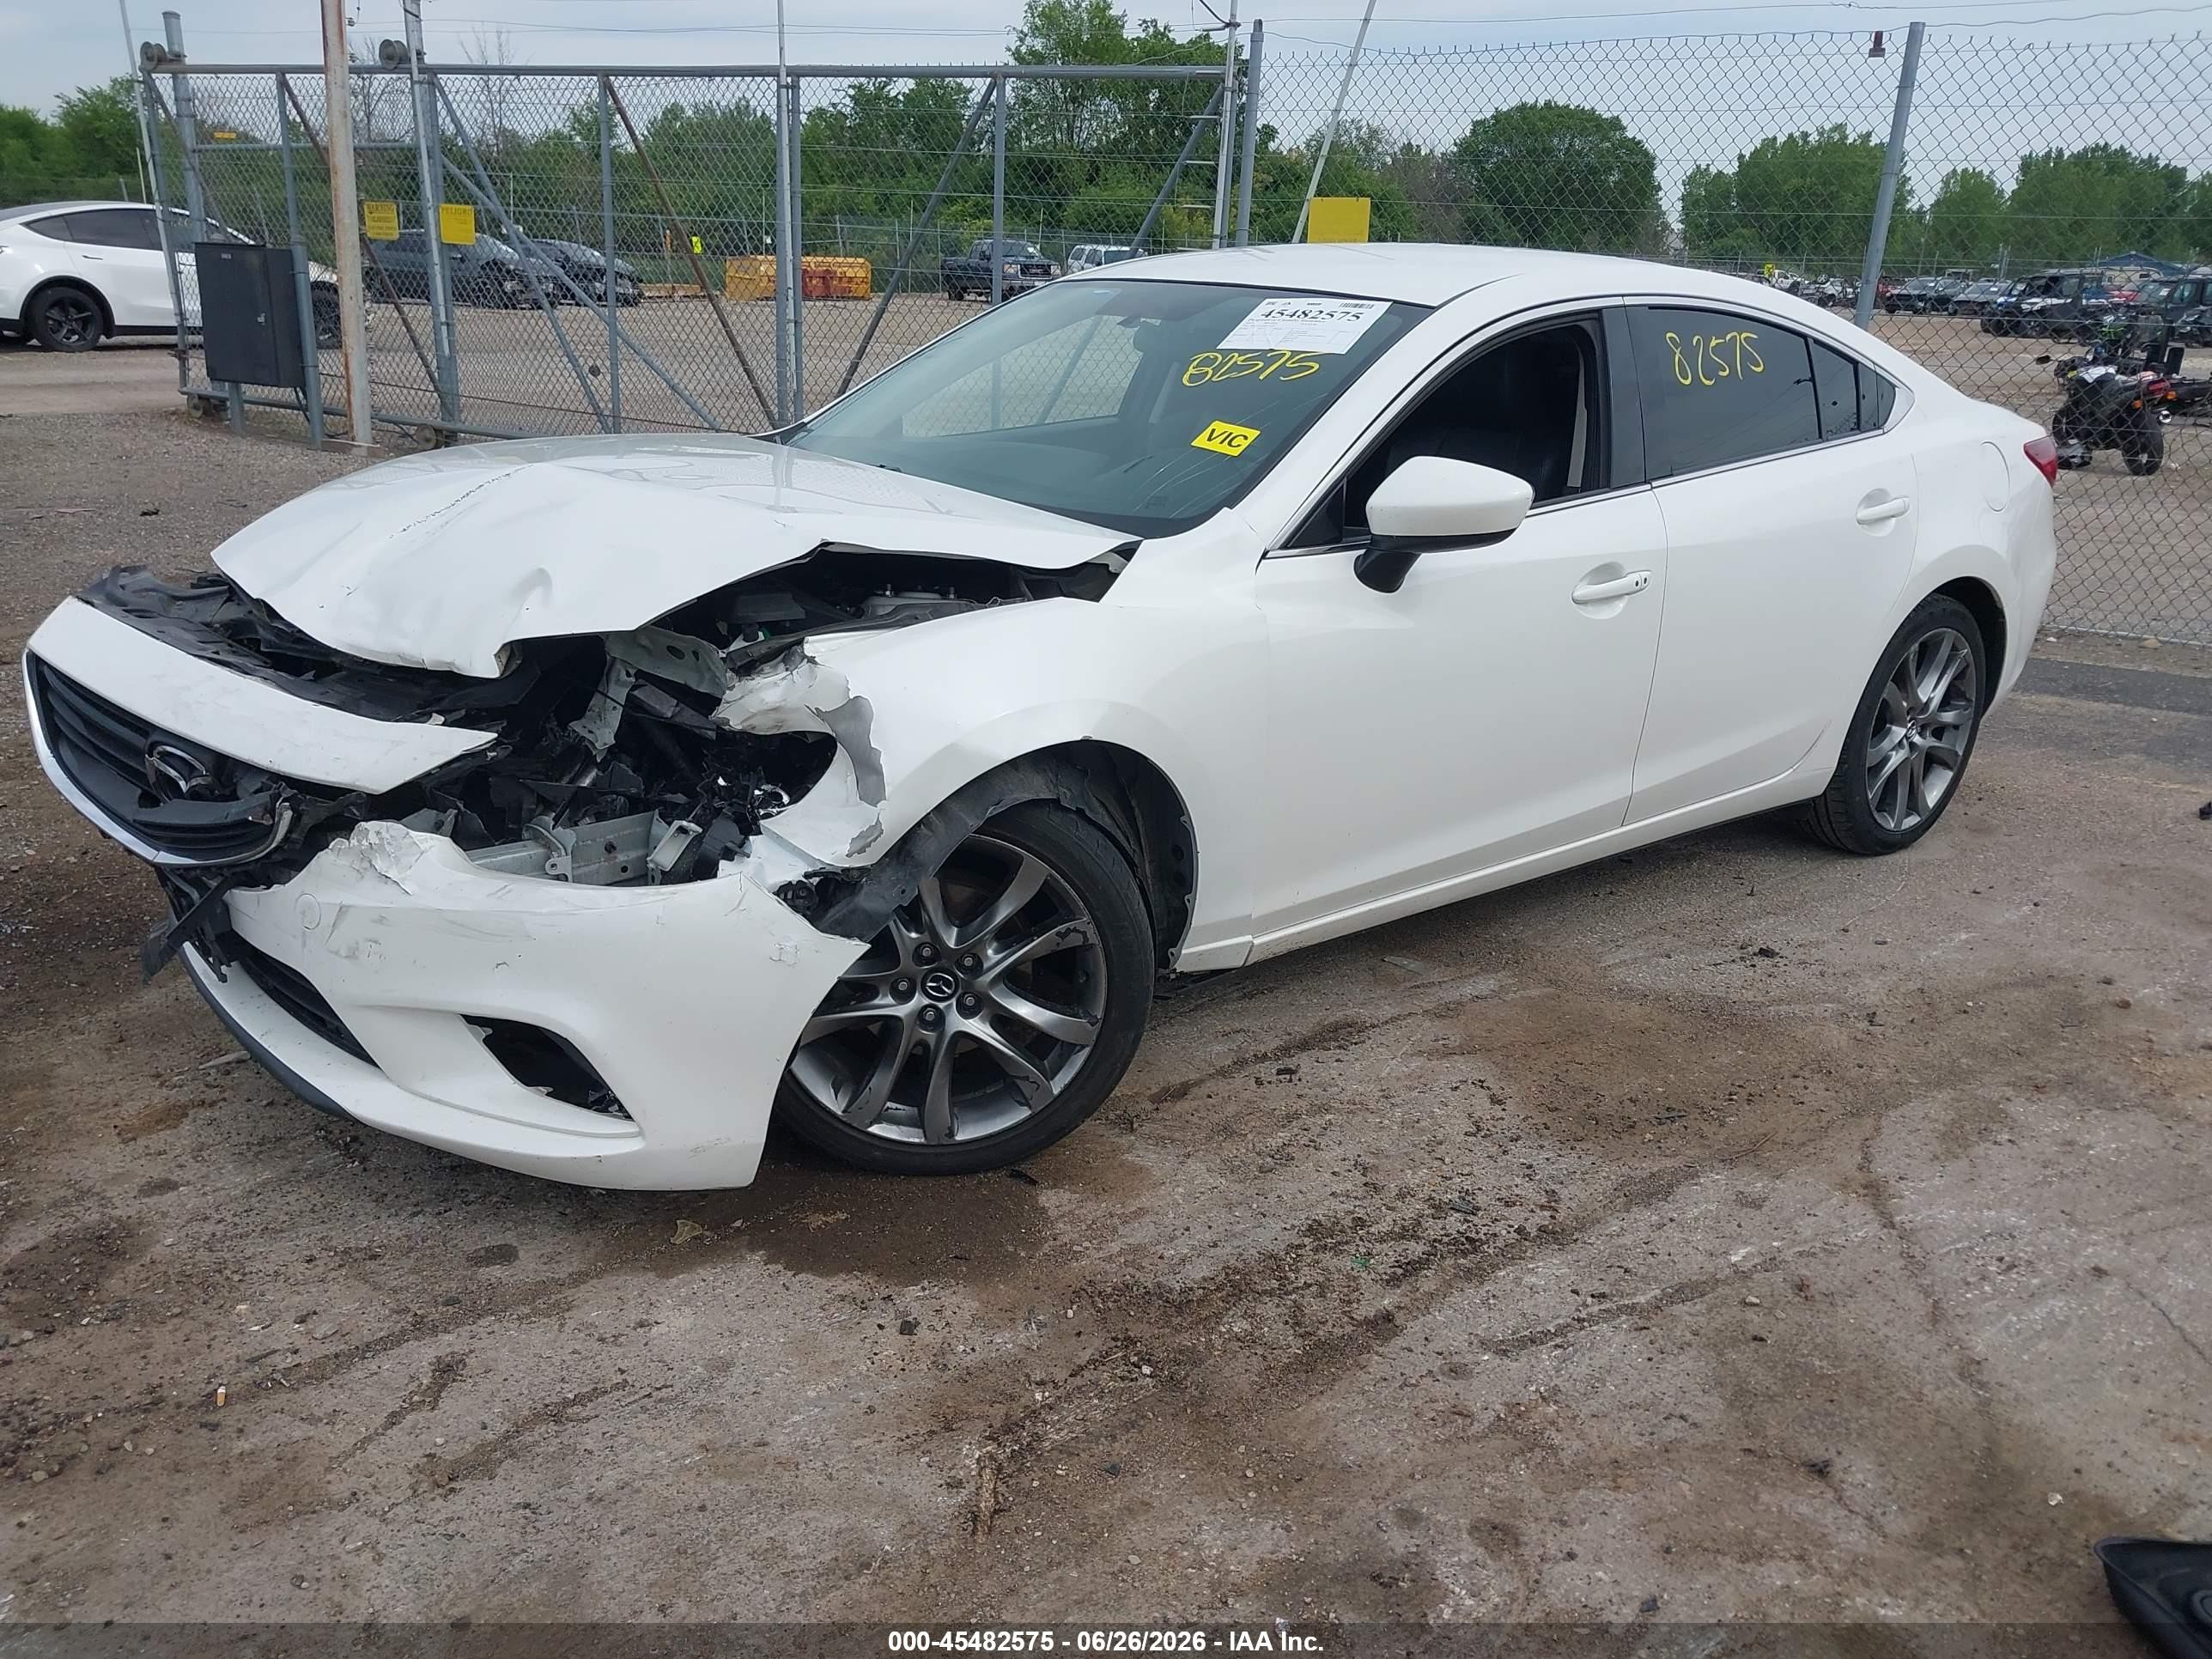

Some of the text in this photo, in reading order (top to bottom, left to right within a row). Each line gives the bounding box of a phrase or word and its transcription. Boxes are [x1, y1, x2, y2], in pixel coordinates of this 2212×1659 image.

[1261, 308, 1364, 322] 45482575
[1182, 349, 1323, 386] 82575
[1666, 331, 1765, 386] 82575
[1206, 428, 1249, 448] VIC
